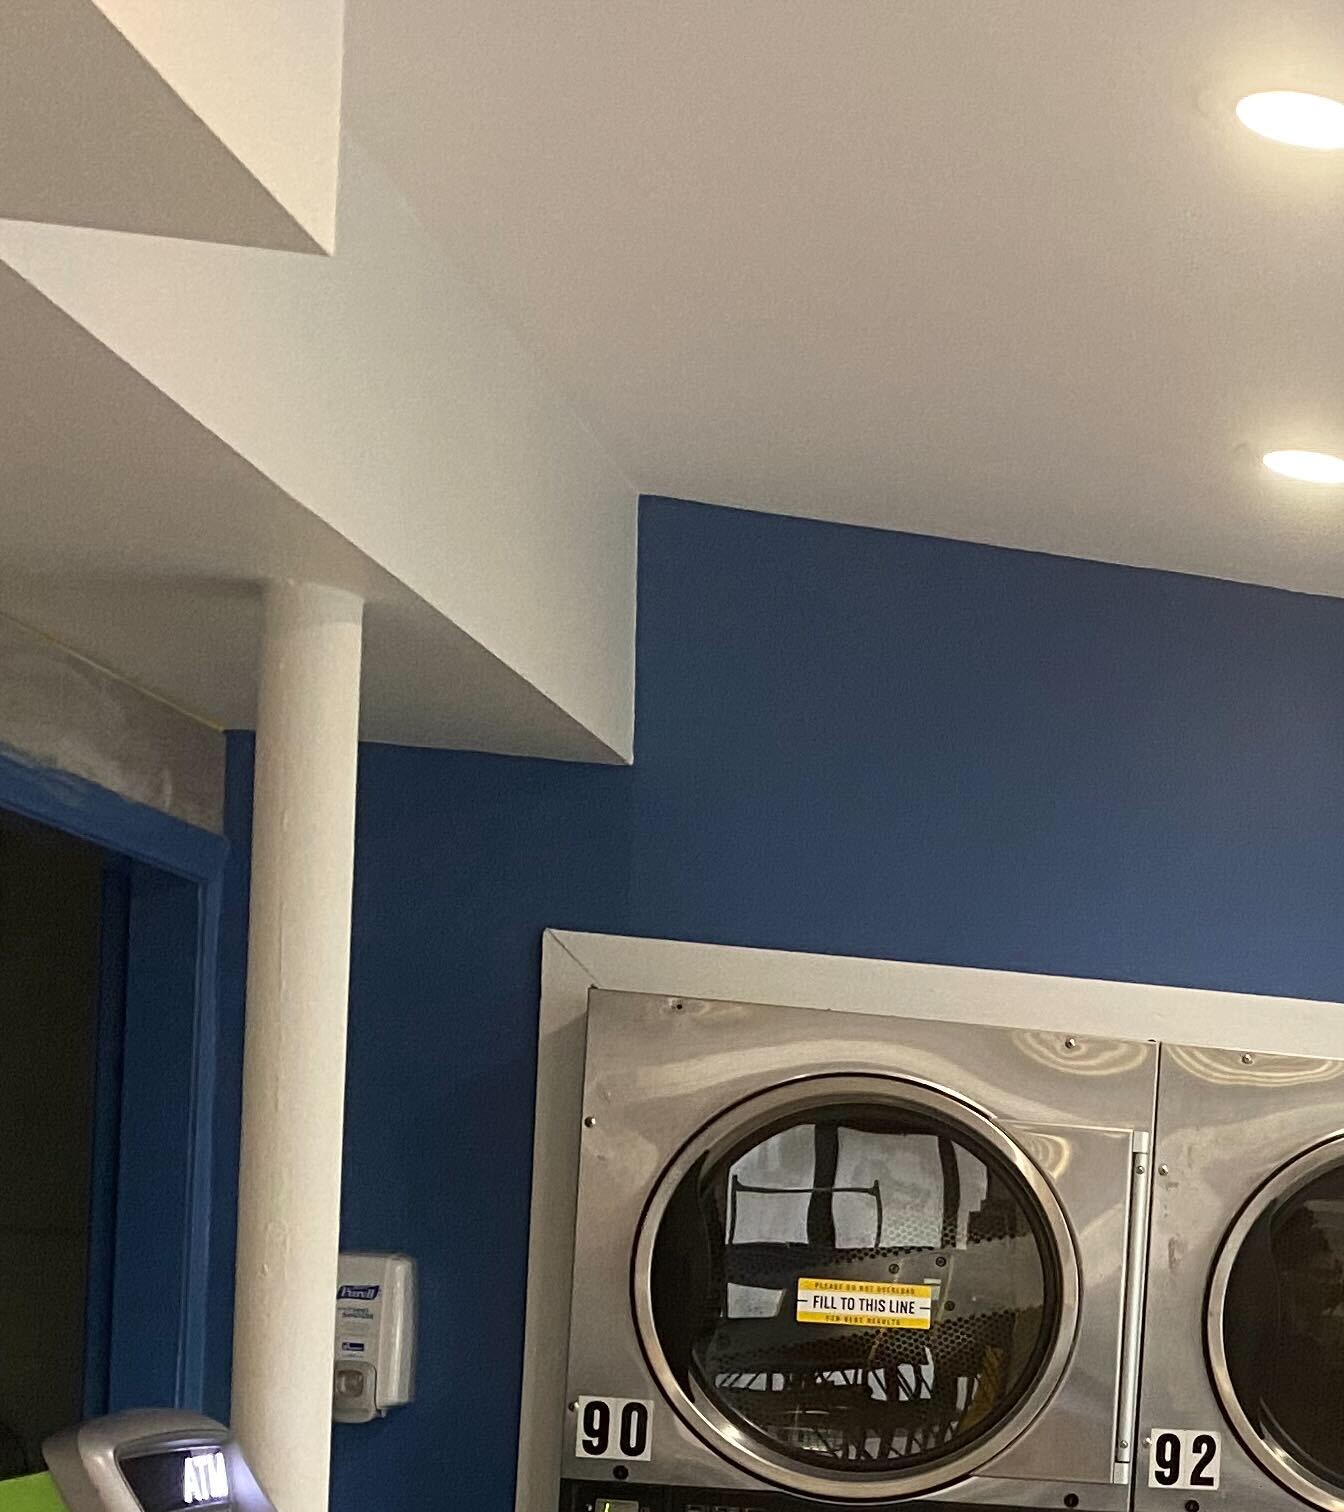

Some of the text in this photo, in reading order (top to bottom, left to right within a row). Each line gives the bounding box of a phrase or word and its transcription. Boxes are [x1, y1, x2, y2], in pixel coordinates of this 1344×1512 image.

[813, 1295, 916, 1314] FILL TO THIS LINE
[582, 1401, 648, 1456] 90
[184, 1452, 229, 1504] ATM
[1154, 1432, 1217, 1486] 92
